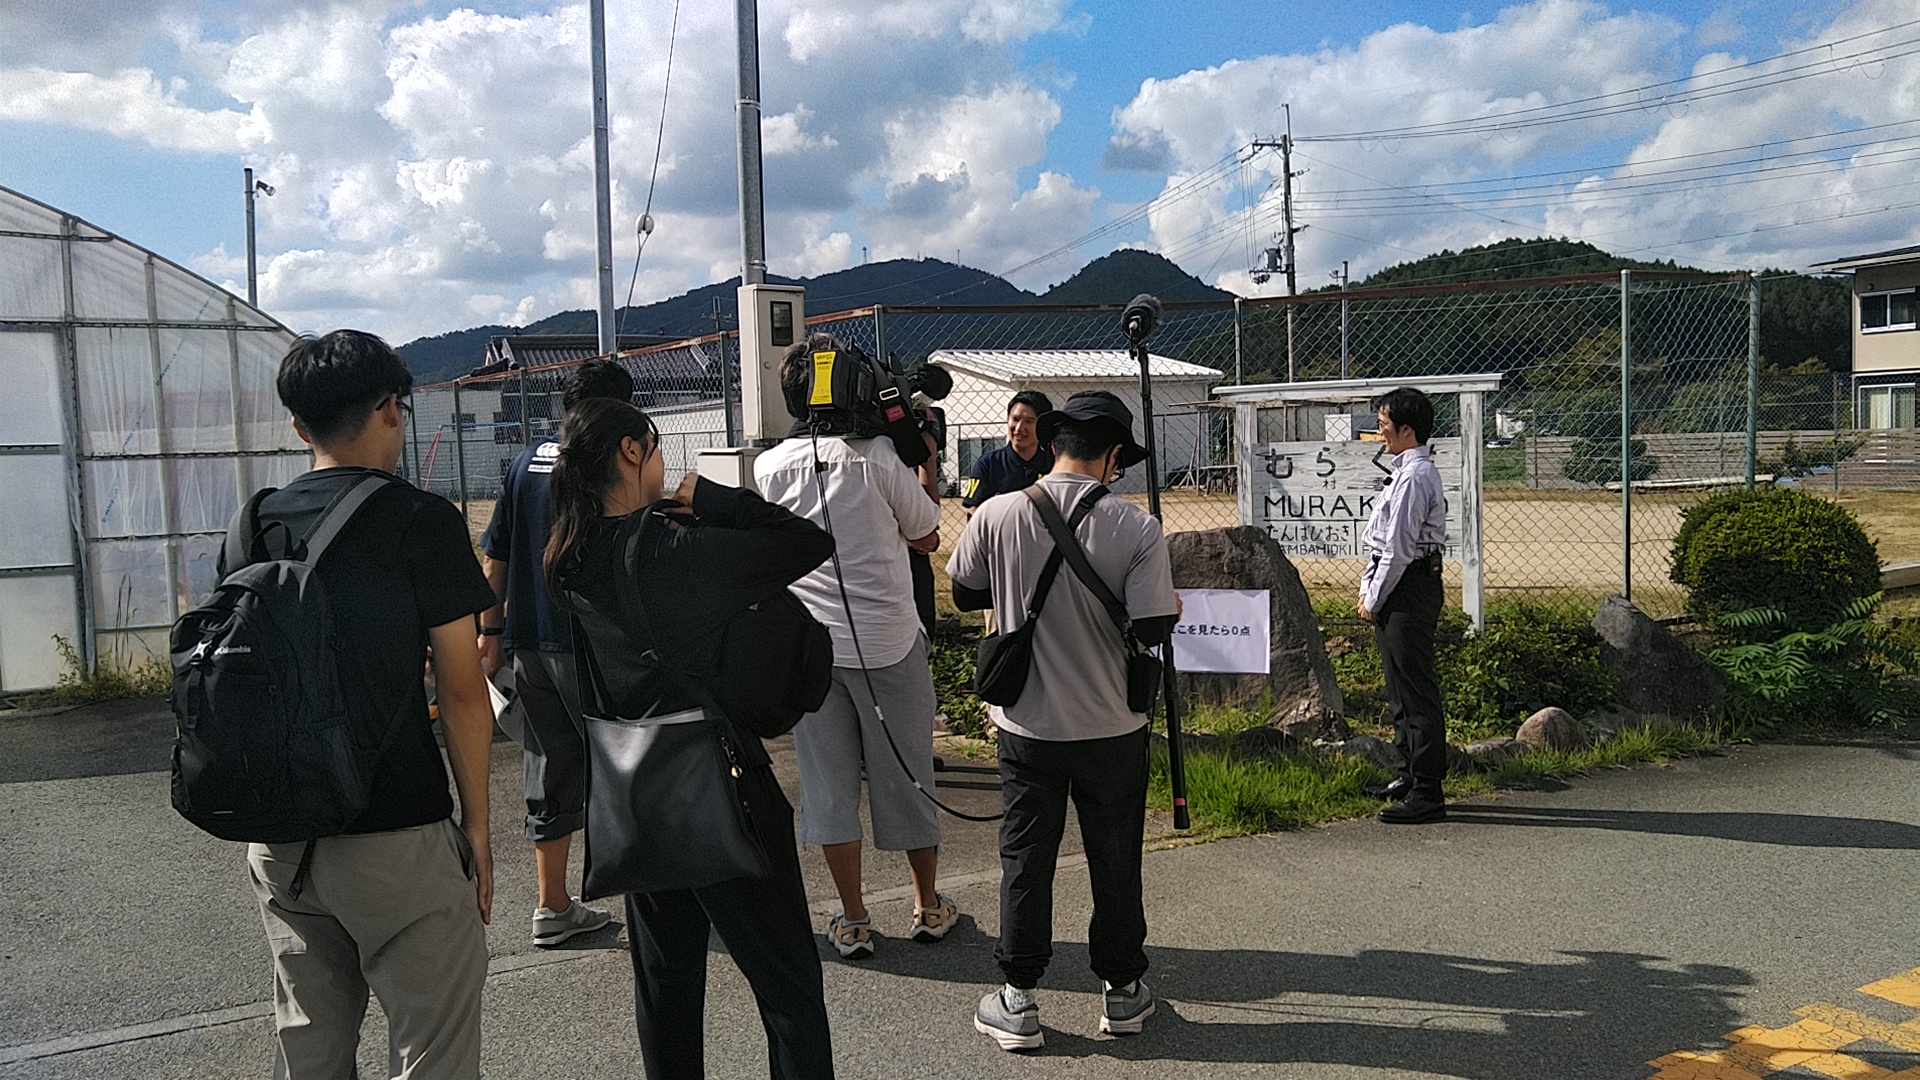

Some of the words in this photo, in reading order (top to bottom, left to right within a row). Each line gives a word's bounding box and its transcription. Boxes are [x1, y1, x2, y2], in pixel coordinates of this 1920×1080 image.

[1264, 444, 1437, 480] むらく
[1263, 494, 1449, 519] MURAK
[1279, 543, 1351, 557] AMBAHIOKI
[1171, 624, 1251, 637] こを見たら0点
